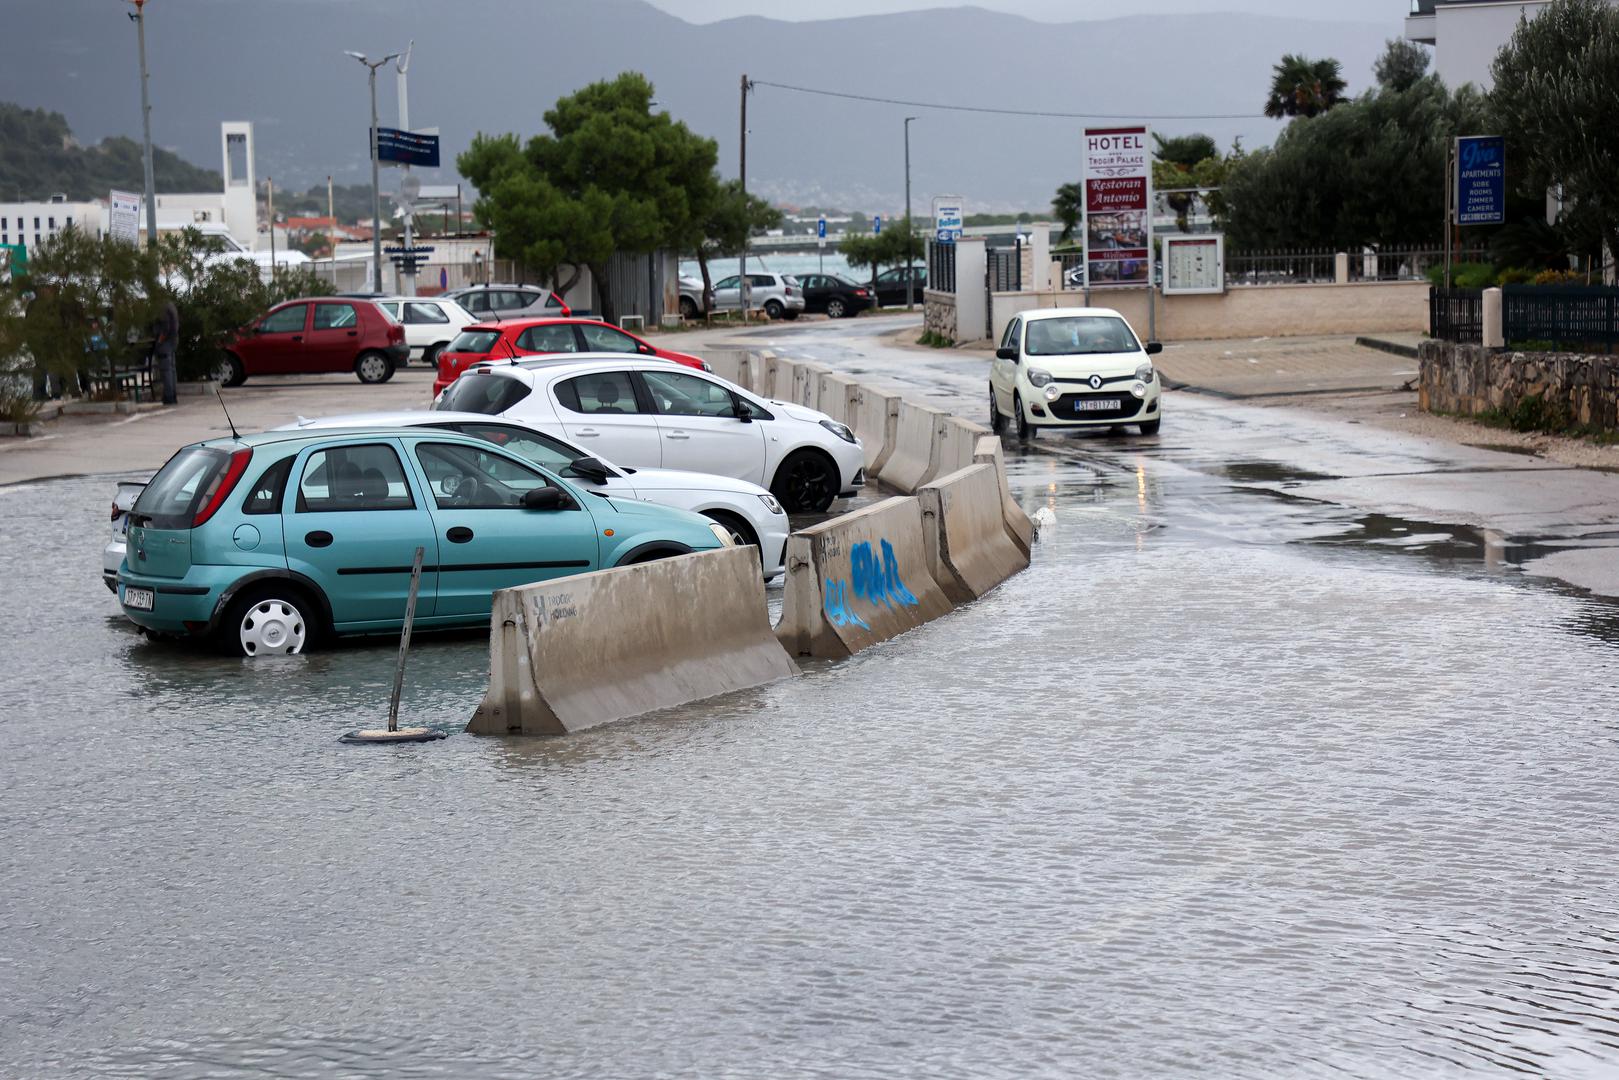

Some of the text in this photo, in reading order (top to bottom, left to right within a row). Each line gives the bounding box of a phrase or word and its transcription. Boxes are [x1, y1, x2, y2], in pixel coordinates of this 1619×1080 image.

[1088, 136, 1144, 150] HOTEL
[1088, 156, 1144, 166] TROGIR PALACE
[1461, 169, 1501, 178] APARTMENTS
[1091, 180, 1141, 191] Restoran
[1092, 191, 1140, 206] Antonio
